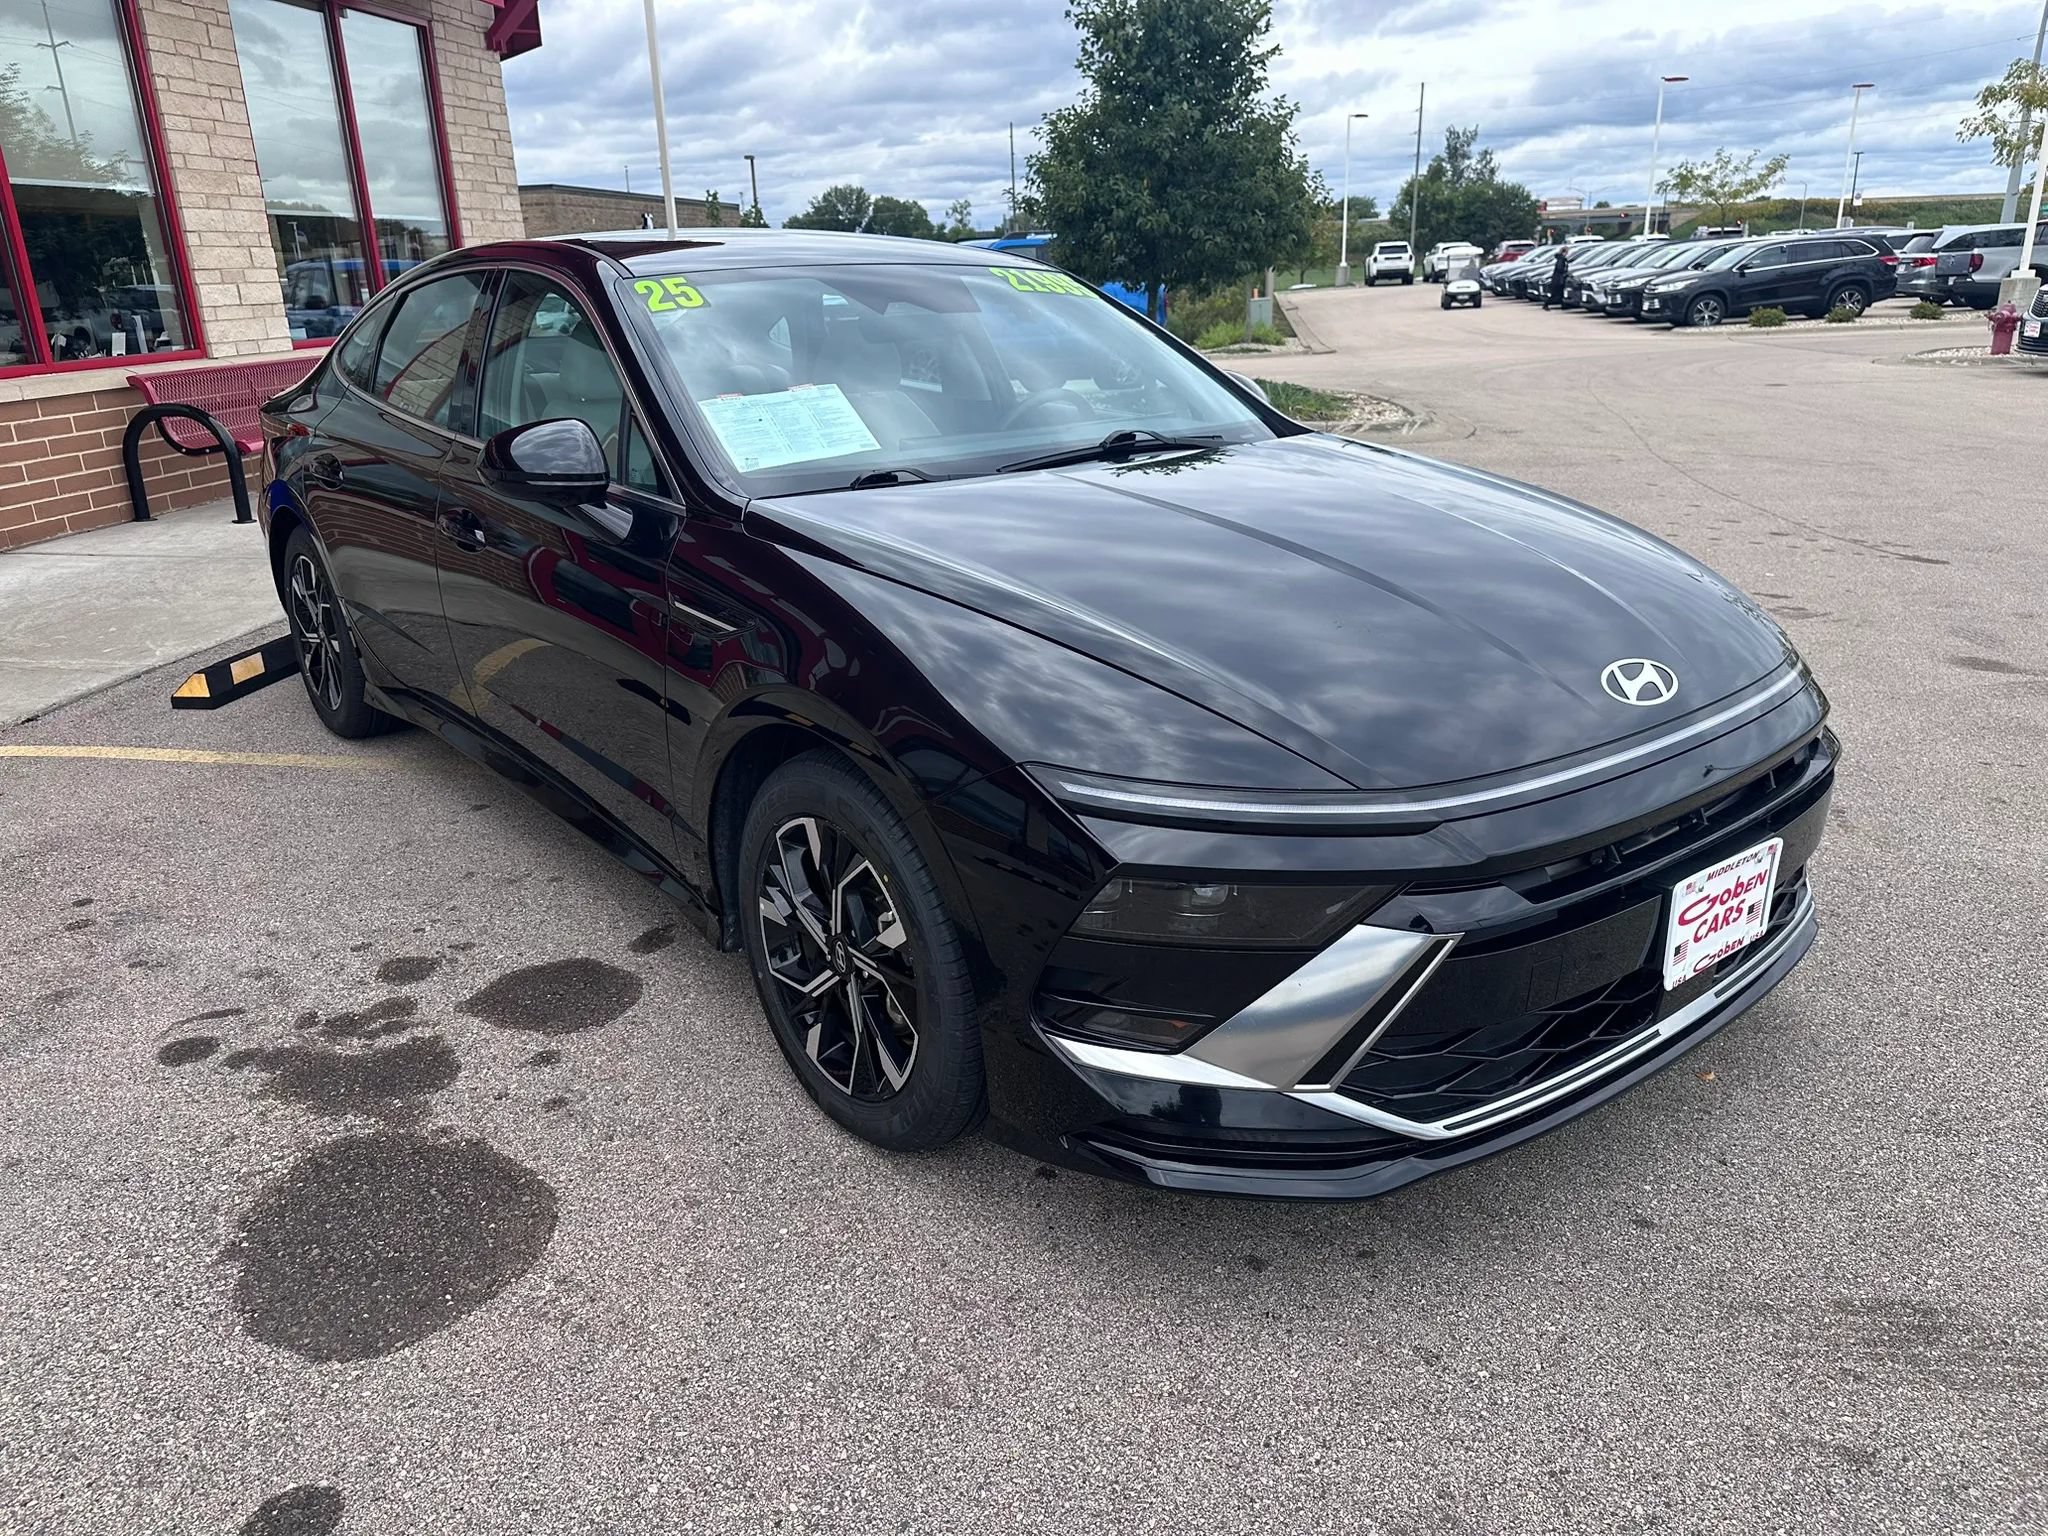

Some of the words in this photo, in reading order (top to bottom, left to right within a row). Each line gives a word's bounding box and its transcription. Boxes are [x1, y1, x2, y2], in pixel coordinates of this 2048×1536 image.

[634, 277, 704, 312] 25
[1706, 851, 1760, 882] MIDDLETON
[1693, 899, 1747, 944] CARS
